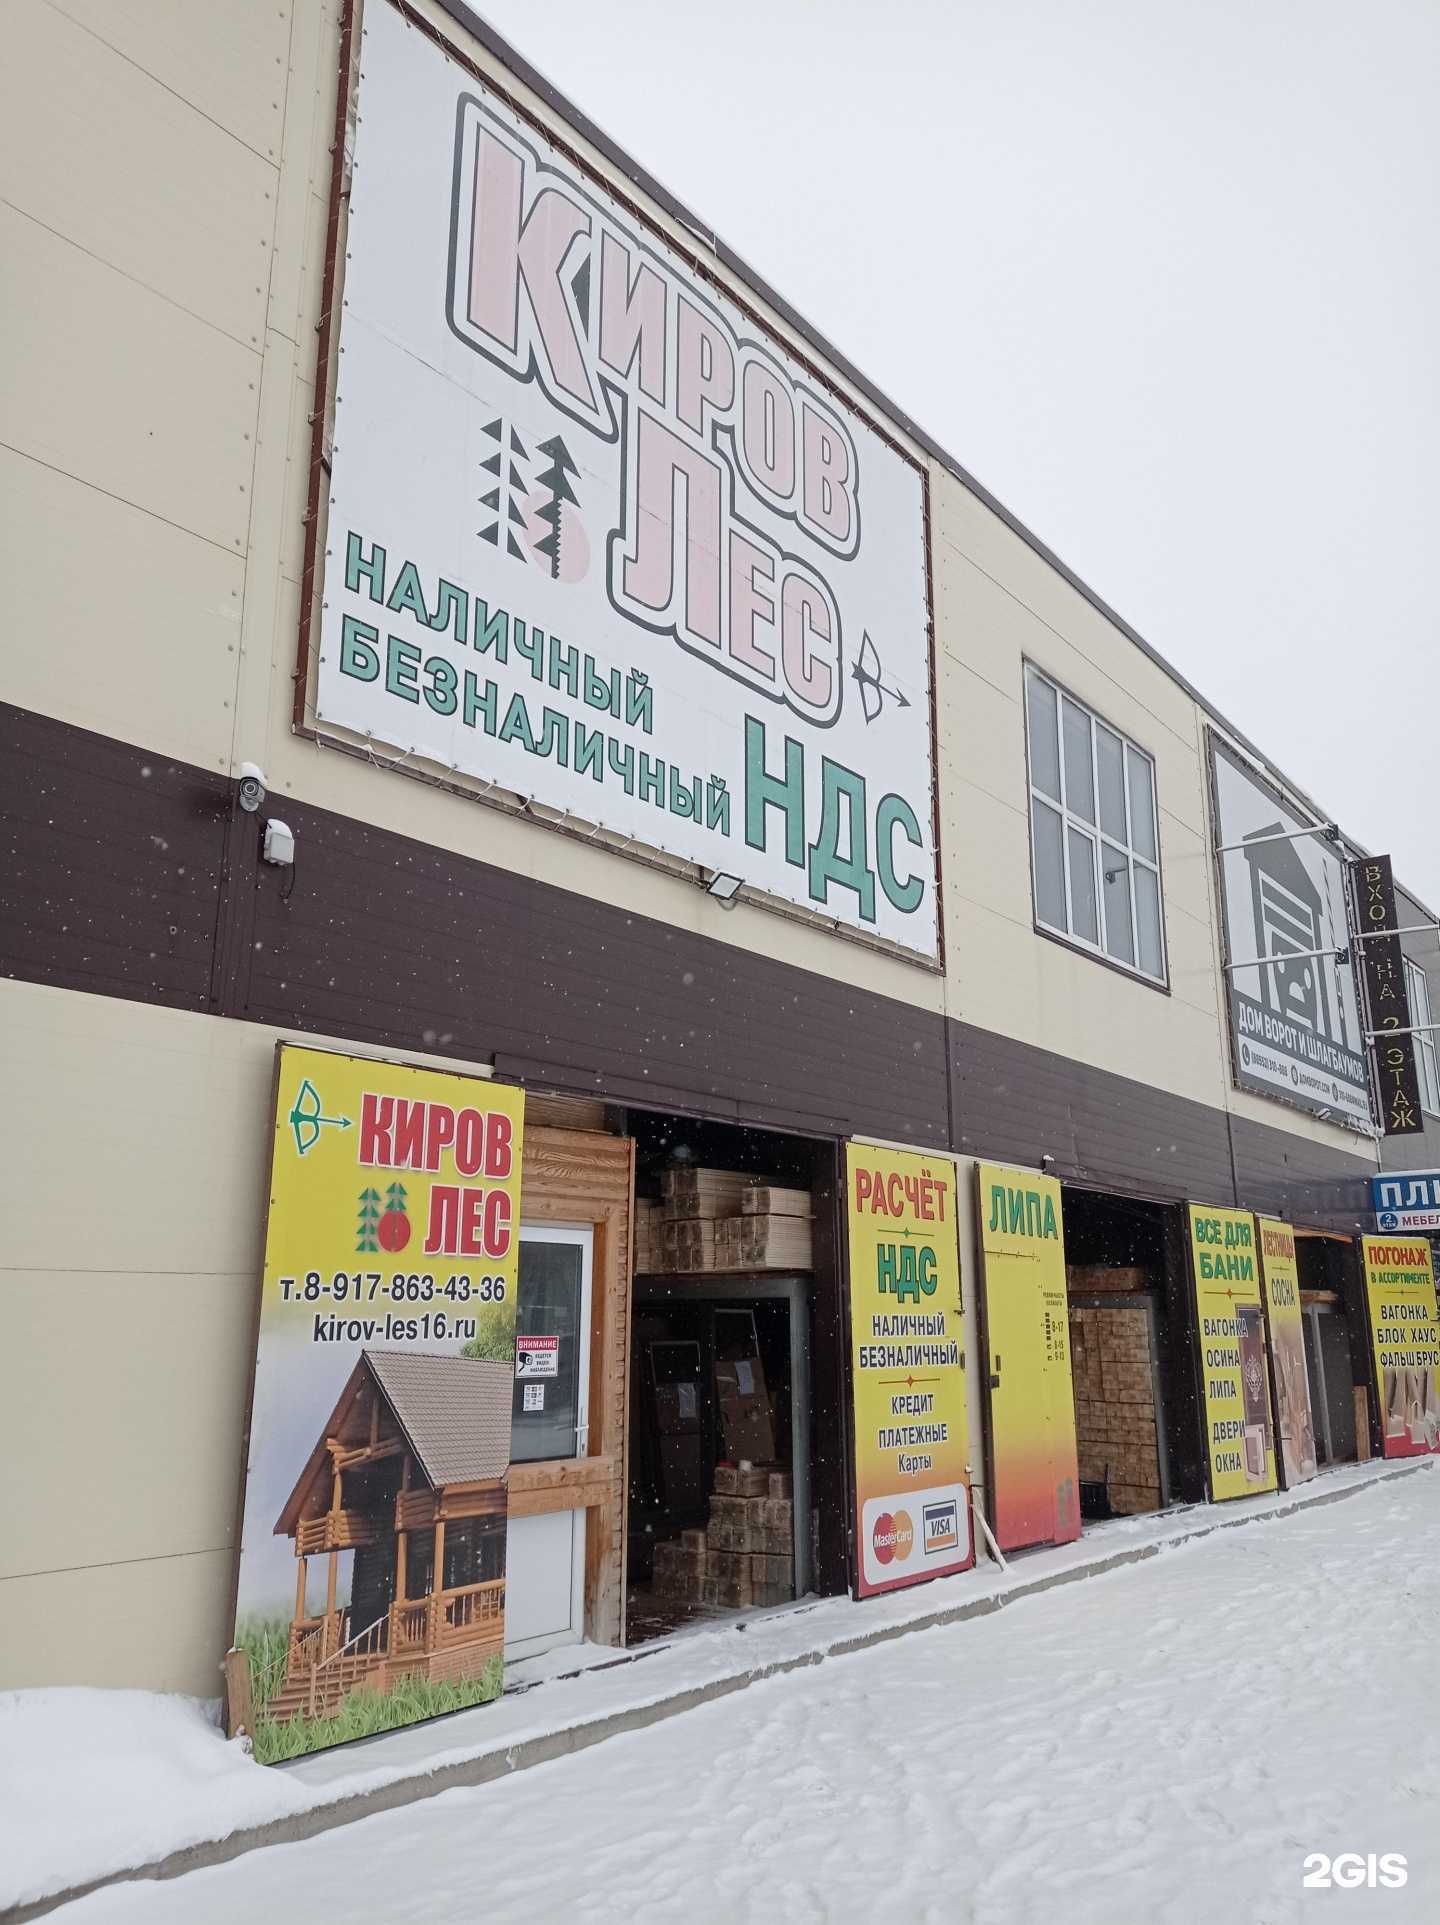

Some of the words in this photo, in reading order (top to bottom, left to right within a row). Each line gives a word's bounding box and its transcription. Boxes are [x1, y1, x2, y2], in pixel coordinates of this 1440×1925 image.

[346, 530, 653, 736] НАЛИЧНЫЙ
[339, 614, 731, 838] БЕЗНАЛИЧНЫЙ
[743, 711, 926, 925] НДС
[1383, 1017, 1401, 1038] 2
[1238, 1001, 1264, 1036] ДОМ
[1264, 1014, 1298, 1052] ВОРОТ
[1298, 1031, 1307, 1057] И
[1307, 1035, 1364, 1083] ШЛАГБАУМОВ
[1386, 1048, 1416, 1129] ЭТАЖ
[359, 1093, 512, 1179] КИРОВ
[856, 1167, 948, 1222] РАСЧЁТ
[423, 1185, 512, 1258] ЛЕС
[989, 1184, 1059, 1240] ЛИПА
[1195, 1217, 1223, 1244] ВСЕ
[1225, 1221, 1252, 1250] ДЛЯ
[1199, 1252, 1254, 1281] БАНИ
[1368, 1246, 1429, 1266] ПОГОНАЖ
[877, 1243, 938, 1304] НДС
[1370, 1272, 1377, 1284] В
[1378, 1272, 1431, 1285] АССОРТИМЕНТЕ
[280, 1272, 505, 1302] т.8-917-863-43-36
[1271, 1277, 1296, 1306] СОСНА
[872, 1312, 945, 1337] НАЛИЧНЫЙ
[1380, 1304, 1429, 1320] ВАГОНКА
[313, 1313, 476, 1342] kirov-les16.ru
[1203, 1318, 1248, 1337] ВАГОНКА
[1377, 1328, 1407, 1344] БЛОК
[1411, 1327, 1437, 1343] ХАУС
[518, 1340, 557, 1349] ВНИМАНИЕ
[859, 1340, 958, 1368] БЕЗНАЛИЧНЫЙ
[1206, 1349, 1241, 1367] ОСИНА
[1209, 1381, 1237, 1399] ЛИПА
[891, 1394, 934, 1416] КРЕДИТ
[878, 1423, 948, 1449] ПЛАТЕЖНЫЕ
[1213, 1420, 1246, 1445] ДВЕРИ
[898, 1454, 932, 1475] Карты
[1215, 1452, 1242, 1473] ОКНА
[874, 1530, 912, 1549] MasterCard
[931, 1518, 951, 1537] VISA
